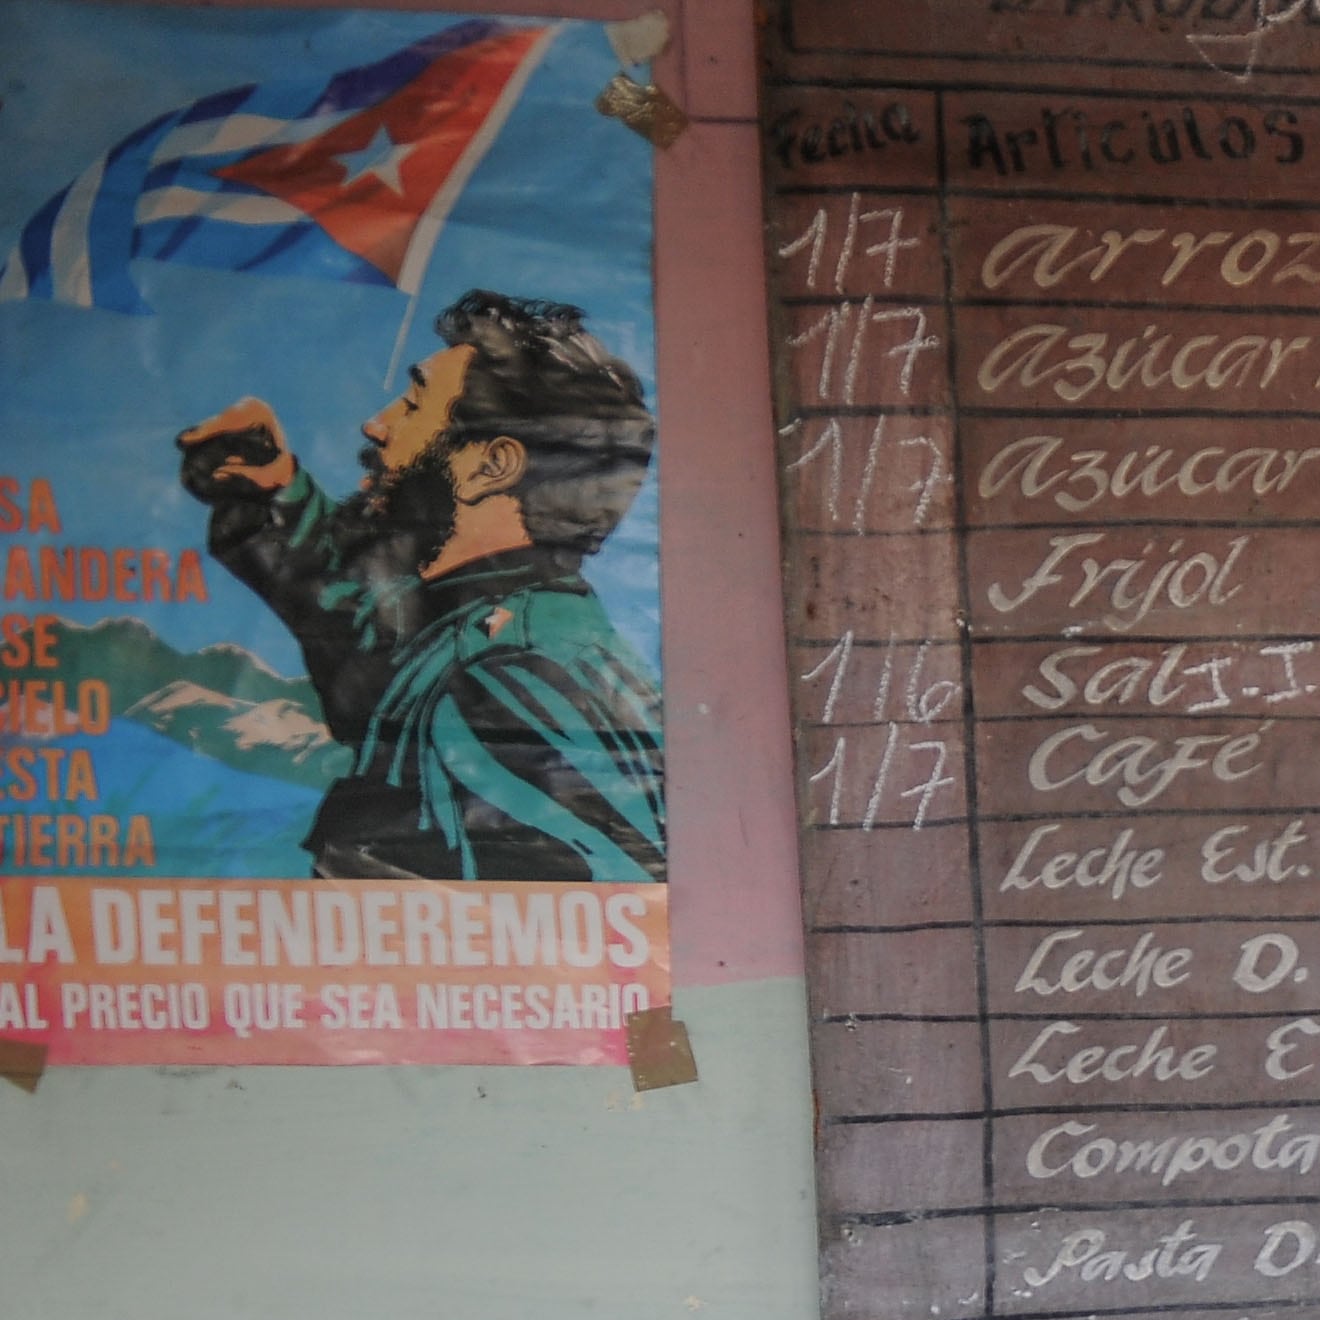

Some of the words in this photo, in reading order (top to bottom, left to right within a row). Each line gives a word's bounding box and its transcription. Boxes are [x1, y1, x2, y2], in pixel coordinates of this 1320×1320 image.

[0, 678, 110, 736] IELO
[1000, 824, 1163, 899] Leche
[0, 886, 75, 963] LA
[90, 888, 650, 969] DEFENDEREMOS
[1014, 929, 1193, 996] Leche
[0, 983, 47, 1029] AL
[61, 983, 209, 1030] PRECIO
[225, 984, 306, 1037] QUE
[321, 985, 399, 1031] SEA
[416, 983, 650, 1031] NECESARIO
[1007, 1020, 1218, 1084] Leche
